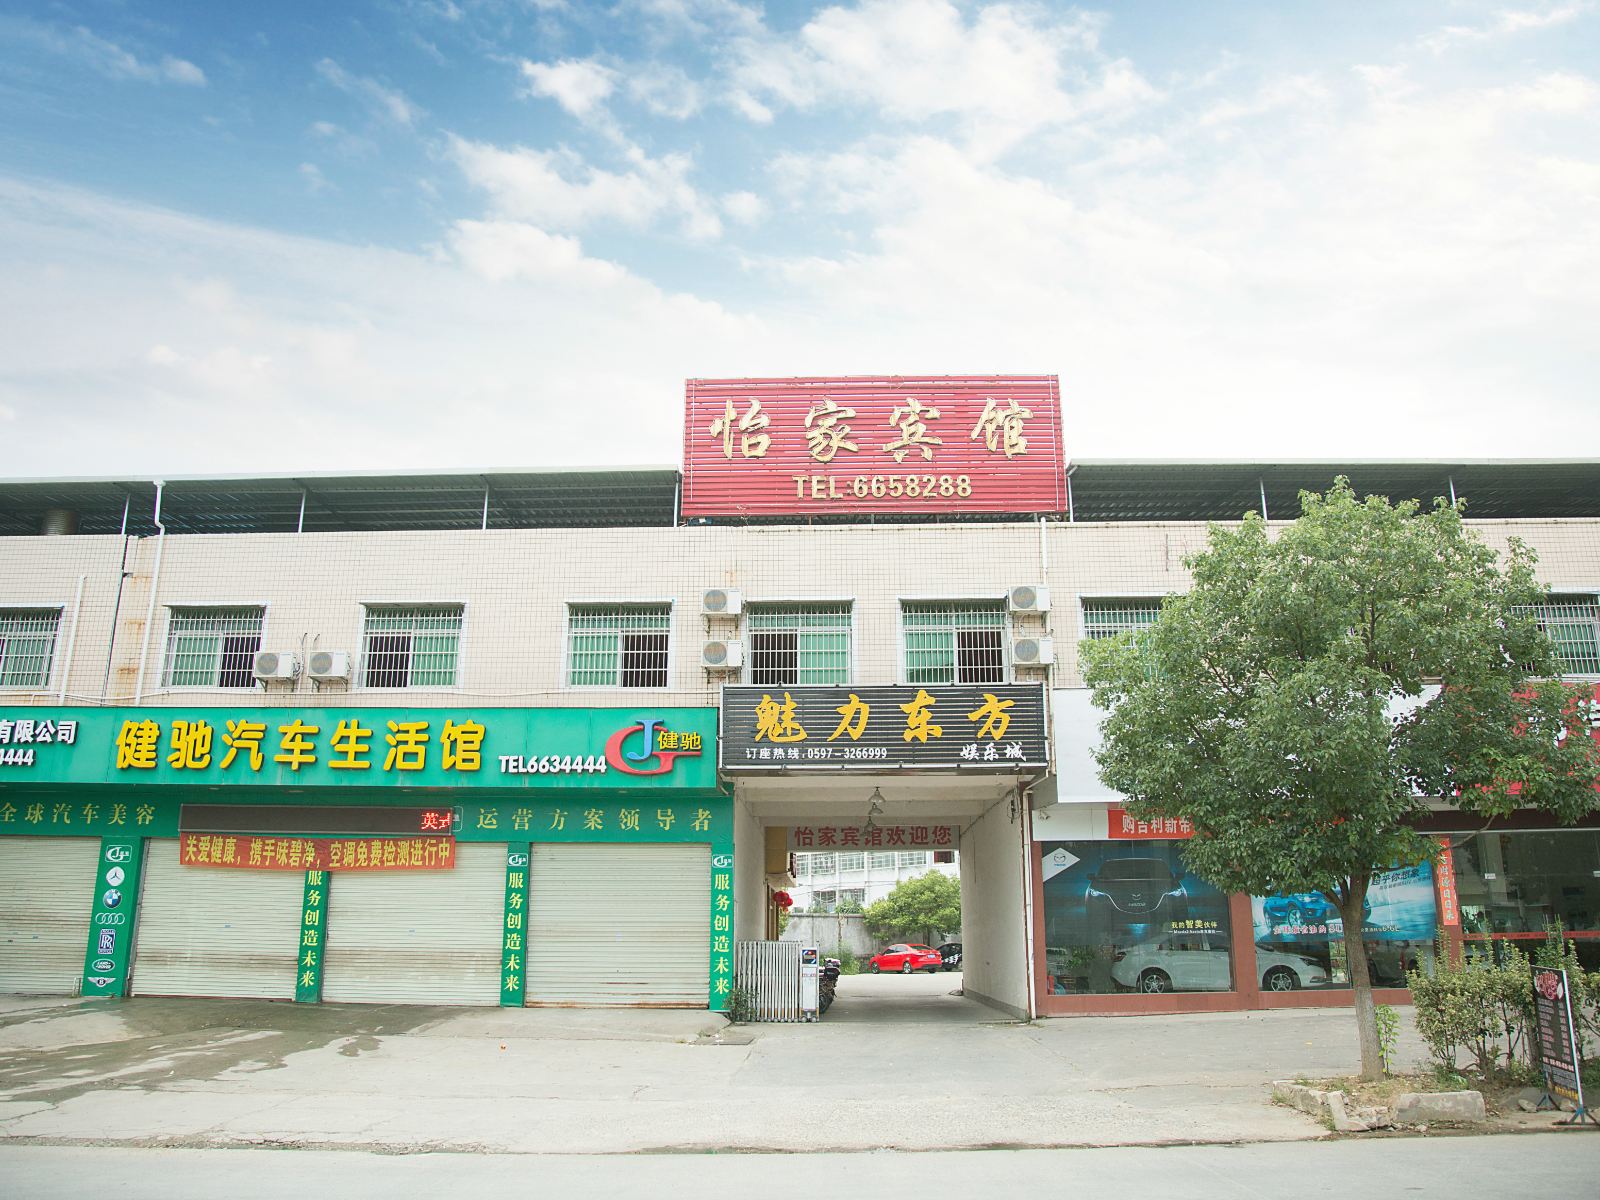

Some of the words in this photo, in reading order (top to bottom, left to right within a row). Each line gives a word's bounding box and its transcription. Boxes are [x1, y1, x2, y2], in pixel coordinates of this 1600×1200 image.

[710, 397, 1034, 463] 怡家宾馆
[793, 475, 972, 499] TEL:6658288
[755, 689, 1015, 743] 魅力东方
[0, 719, 77, 744] 有限公司
[657, 731, 701, 750] 健驰
[116, 719, 485, 771] 健驰汽车生活馆
[959, 742, 1026, 762] 娱乐城
[0, 802, 156, 825] 全球汽车美容
[477, 808, 713, 831] 运营方案领导者
[795, 825, 952, 847] 怡家宾馆欢迎您
[300, 870, 322, 987] 服务创造未来
[504, 872, 524, 991] 服务创造未来
[713, 874, 730, 994] 服务创造未来
